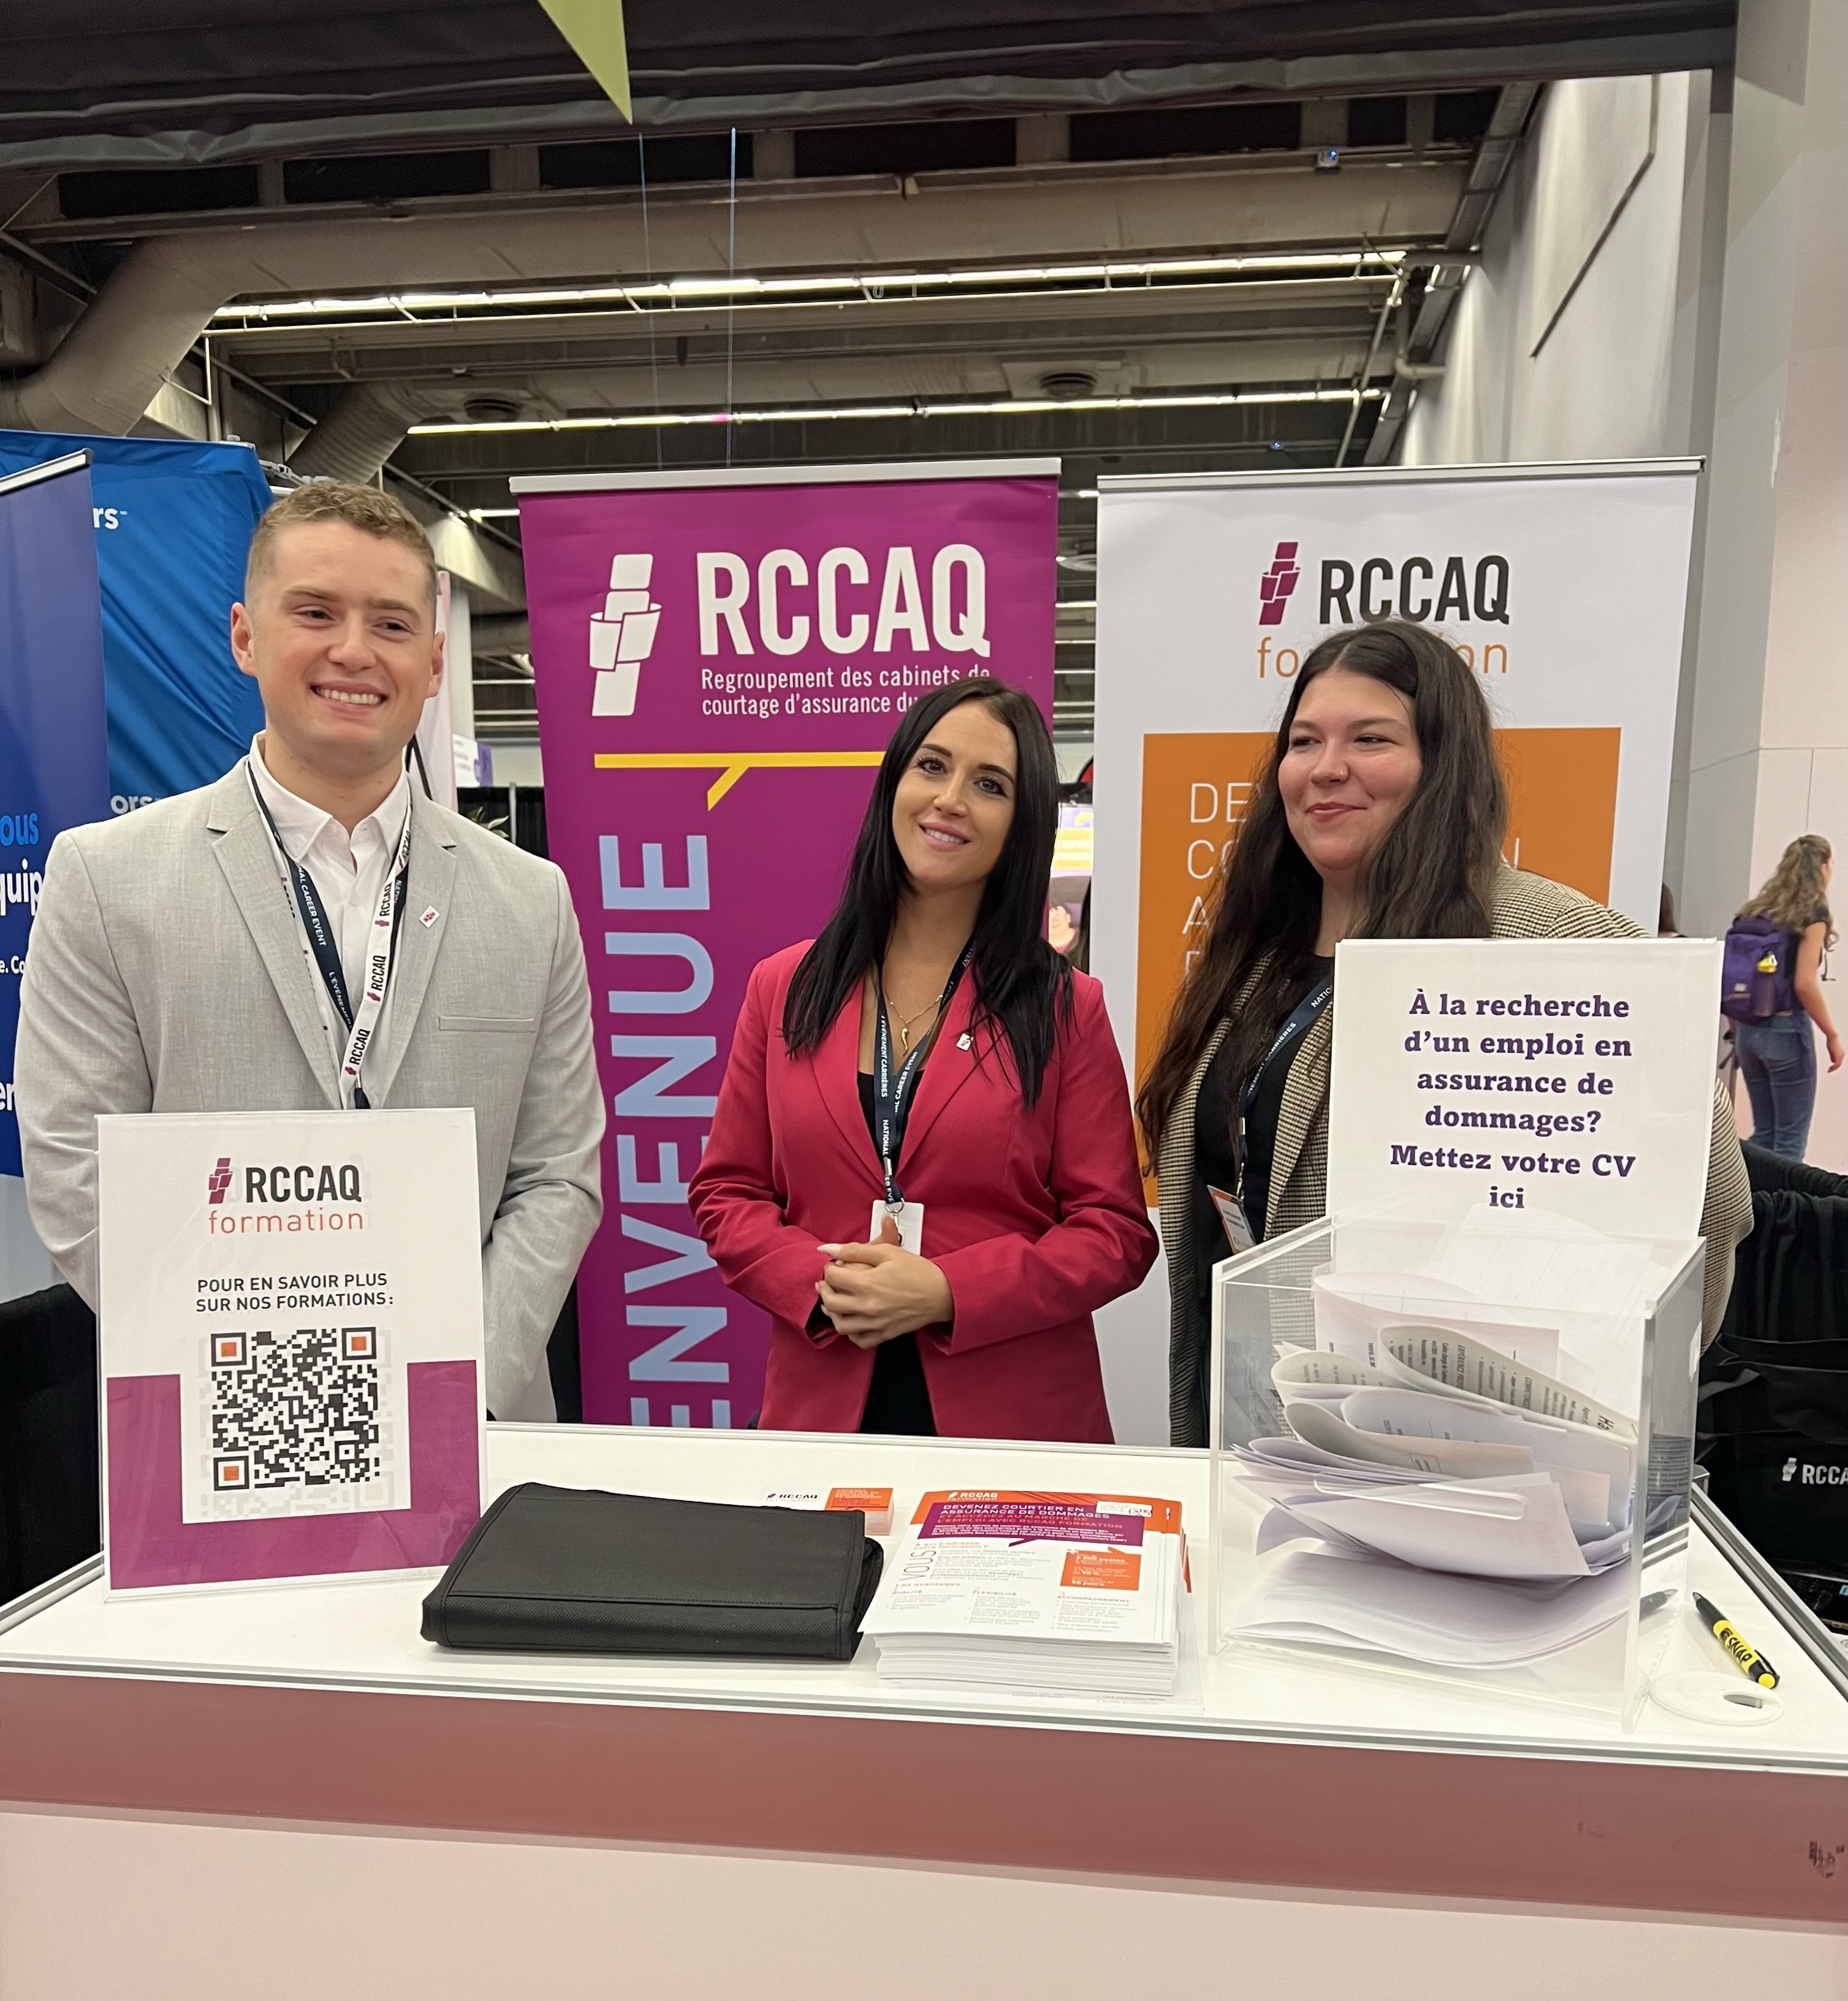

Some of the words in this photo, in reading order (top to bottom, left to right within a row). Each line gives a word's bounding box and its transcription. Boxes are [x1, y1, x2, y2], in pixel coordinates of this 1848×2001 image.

[696, 544, 991, 657] RCCAQ
[1320, 554, 1510, 625] RCCAQ
[701, 668, 834, 693] Regroupement
[840, 666, 872, 688] des
[880, 665, 960, 687] cabinets
[702, 695, 780, 718] courtage
[784, 692, 891, 715] d'assurance
[1190, 782, 1261, 823] DE
[379, 881, 392, 917] RCCAQ
[301, 885, 318, 917] CAREER
[312, 918, 327, 947] EVENT
[371, 955, 387, 992] RCCAQ
[1310, 986, 1332, 1008] NATIO
[1409, 988, 1430, 1015] À
[1439, 994, 1466, 1015] la
[1475, 994, 1630, 1018] recherche
[349, 1028, 371, 1065] RCCAQ
[1404, 1030, 1470, 1053] d'un
[1480, 1032, 1584, 1060] emploi
[1595, 1039, 1632, 1057] en
[881, 1059, 889, 1098] CARRIÈRES
[894, 1071, 908, 1100] CAREER
[1417, 1071, 1567, 1094] assurance
[1578, 1072, 1614, 1095] de
[1425, 1105, 1602, 1137] dommages?
[1390, 1145, 1491, 1170] Mettez
[1501, 1151, 1581, 1175] votre
[1592, 1154, 1636, 1178] CV
[245, 1164, 362, 1203] RCCAQ
[1489, 1185, 1525, 1209] ici
[208, 1206, 364, 1235] formation
[197, 1278, 245, 1293] POUR
[250, 1277, 273, 1290] EN
[278, 1274, 339, 1290] SAVOIR
[344, 1273, 388, 1287] PLUS
[196, 1297, 232, 1313] SUR
[237, 1295, 272, 1311] NOS
[1038, 1510, 1110, 1519] DOMMAGES
[899, 1550, 937, 1581] VOUS
[1725, 1636, 1753, 1667] SNAP
